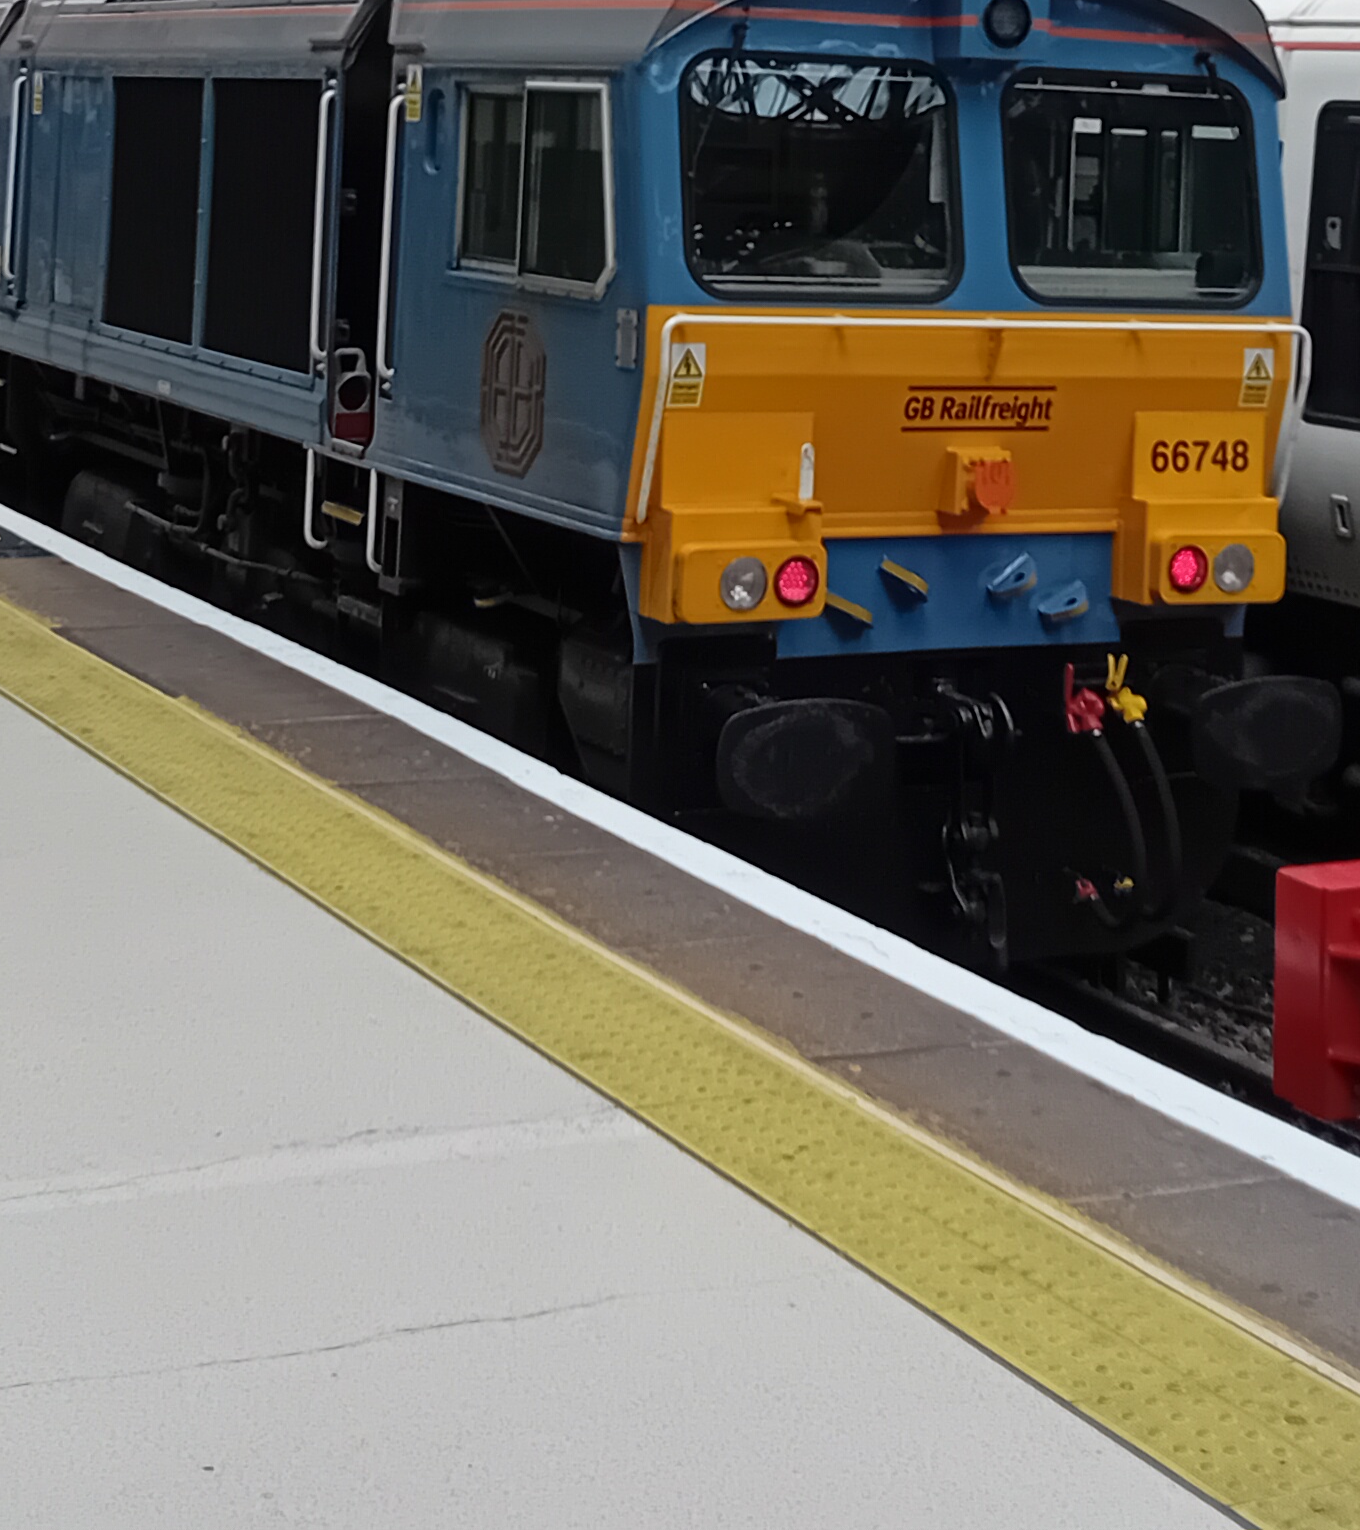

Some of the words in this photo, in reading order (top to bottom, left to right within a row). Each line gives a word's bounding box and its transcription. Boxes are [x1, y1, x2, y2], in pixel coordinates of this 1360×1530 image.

[904, 396, 935, 421] GB
[940, 394, 1053, 428] Railfreight
[1151, 439, 1249, 473] 66748
